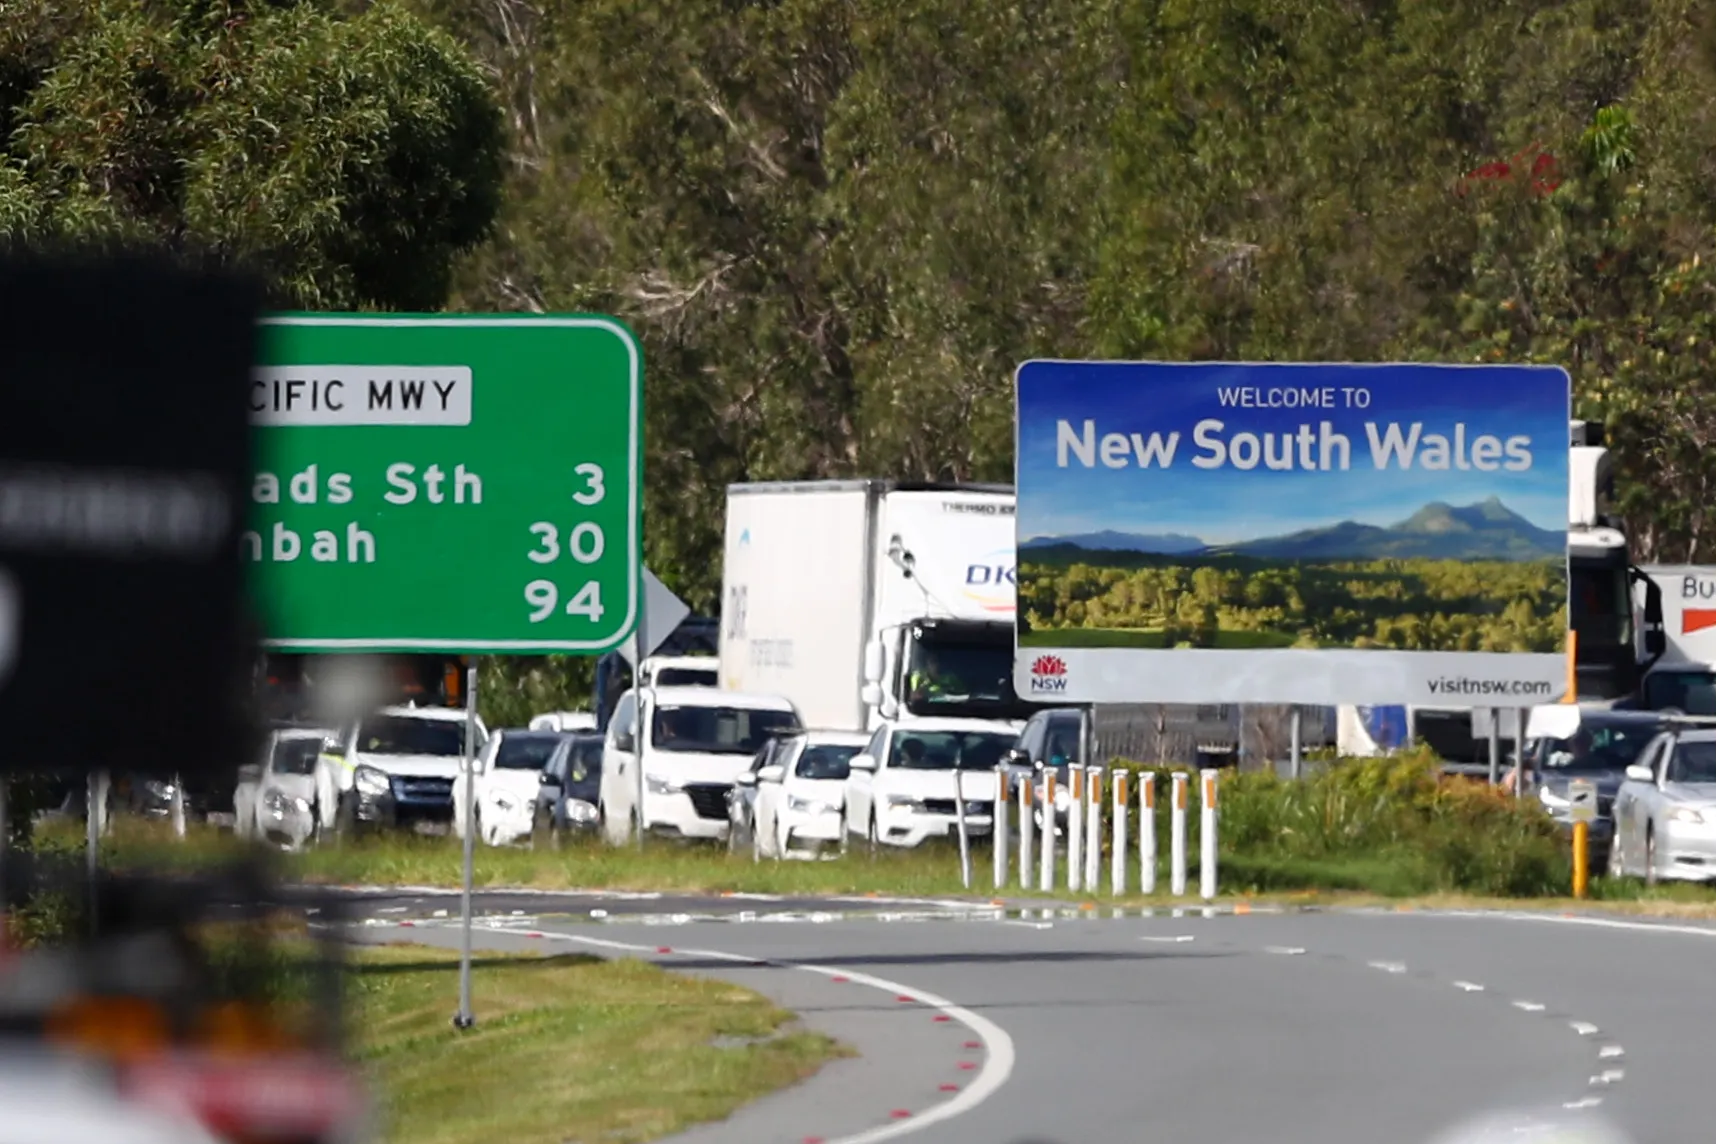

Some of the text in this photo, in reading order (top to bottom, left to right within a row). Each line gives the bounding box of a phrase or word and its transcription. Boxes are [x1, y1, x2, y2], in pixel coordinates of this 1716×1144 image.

[368, 379, 456, 411] MWY
[1217, 387, 1371, 408] WELCOME TO
[1056, 418, 1533, 472] New South Wales
[383, 462, 482, 505] Sth
[572, 462, 606, 505] 3
[527, 521, 605, 564] 30
[524, 579, 605, 623] 94
[1031, 677, 1068, 690] NSW
[1427, 675, 1552, 695] visitnsw.com
